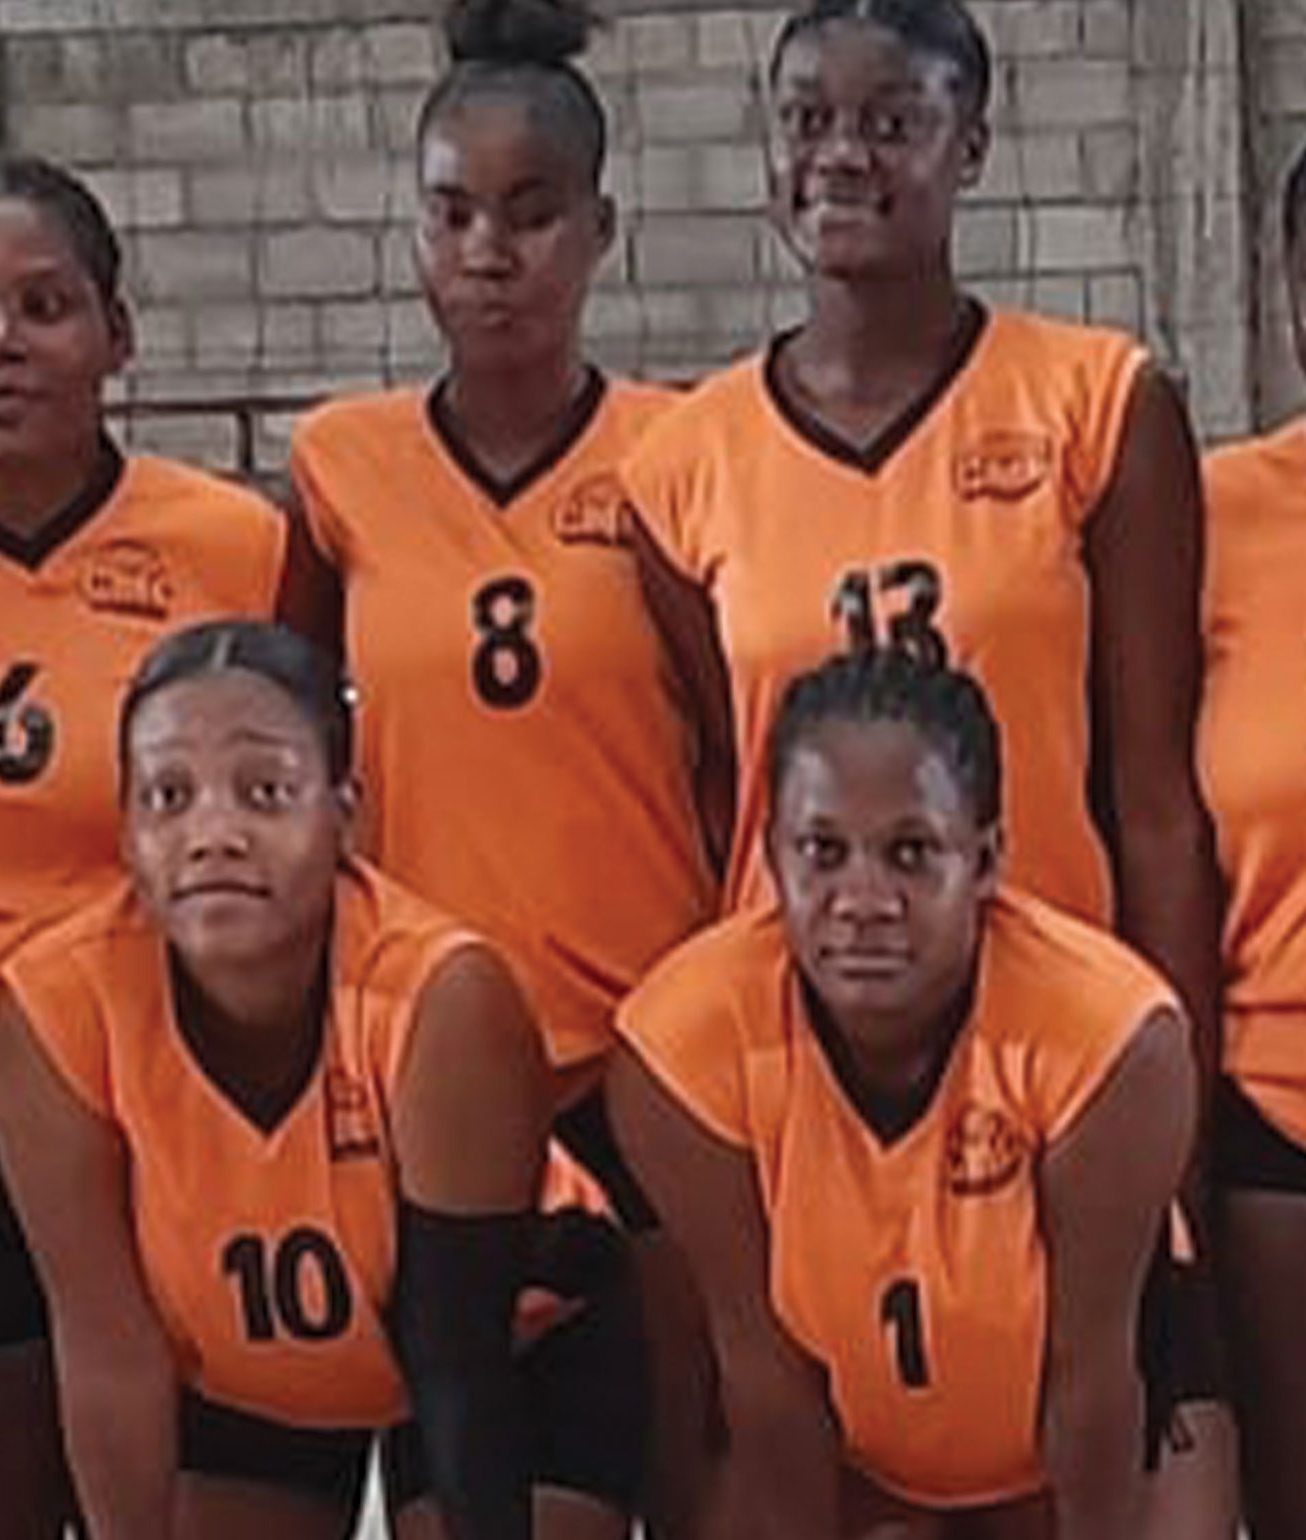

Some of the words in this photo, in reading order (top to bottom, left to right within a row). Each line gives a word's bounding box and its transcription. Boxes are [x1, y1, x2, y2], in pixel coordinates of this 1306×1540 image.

[471, 576, 541, 710] 8
[221, 1227, 355, 1342] 10
[880, 1278, 929, 1390] 1
